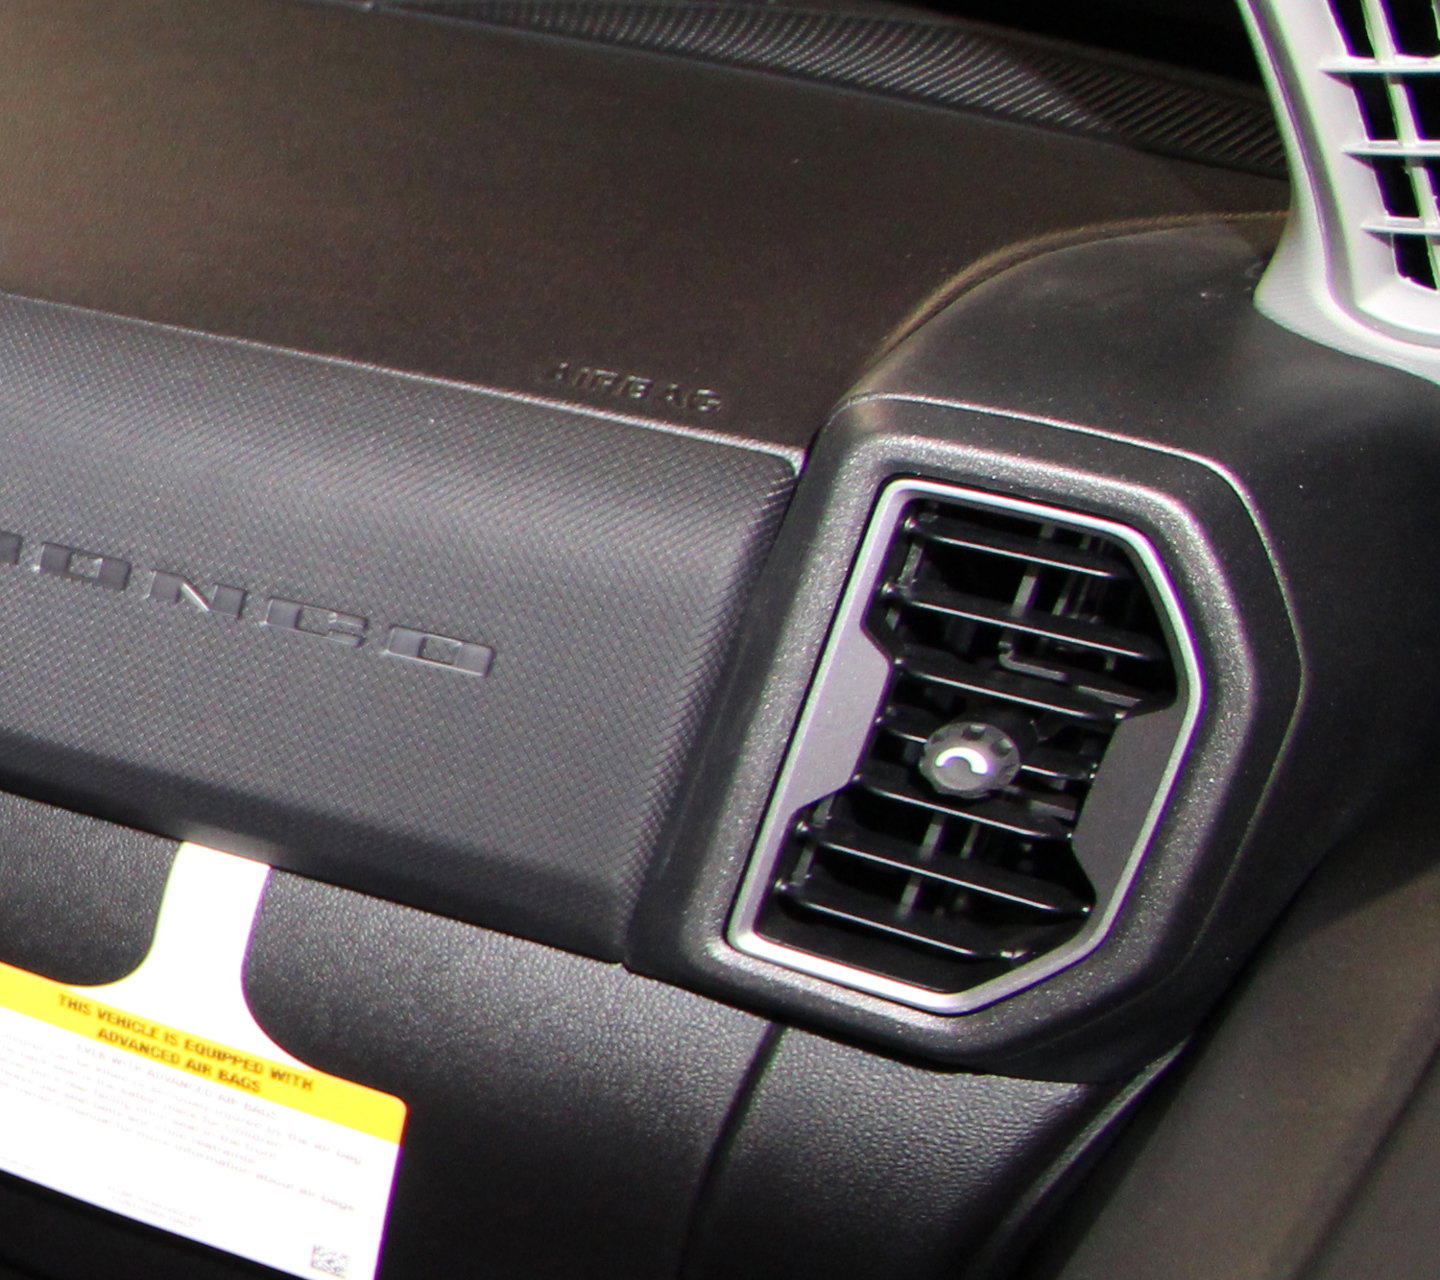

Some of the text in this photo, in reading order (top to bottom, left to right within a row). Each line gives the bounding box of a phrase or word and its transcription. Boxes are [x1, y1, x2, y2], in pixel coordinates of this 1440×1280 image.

[56, 993, 314, 1091] THIS VEHICLE IS EQUIPPED WITH
[96, 1027, 181, 1065] ADVANCED
[184, 1057, 214, 1076] AIR
[216, 1067, 263, 1093] BAGS
